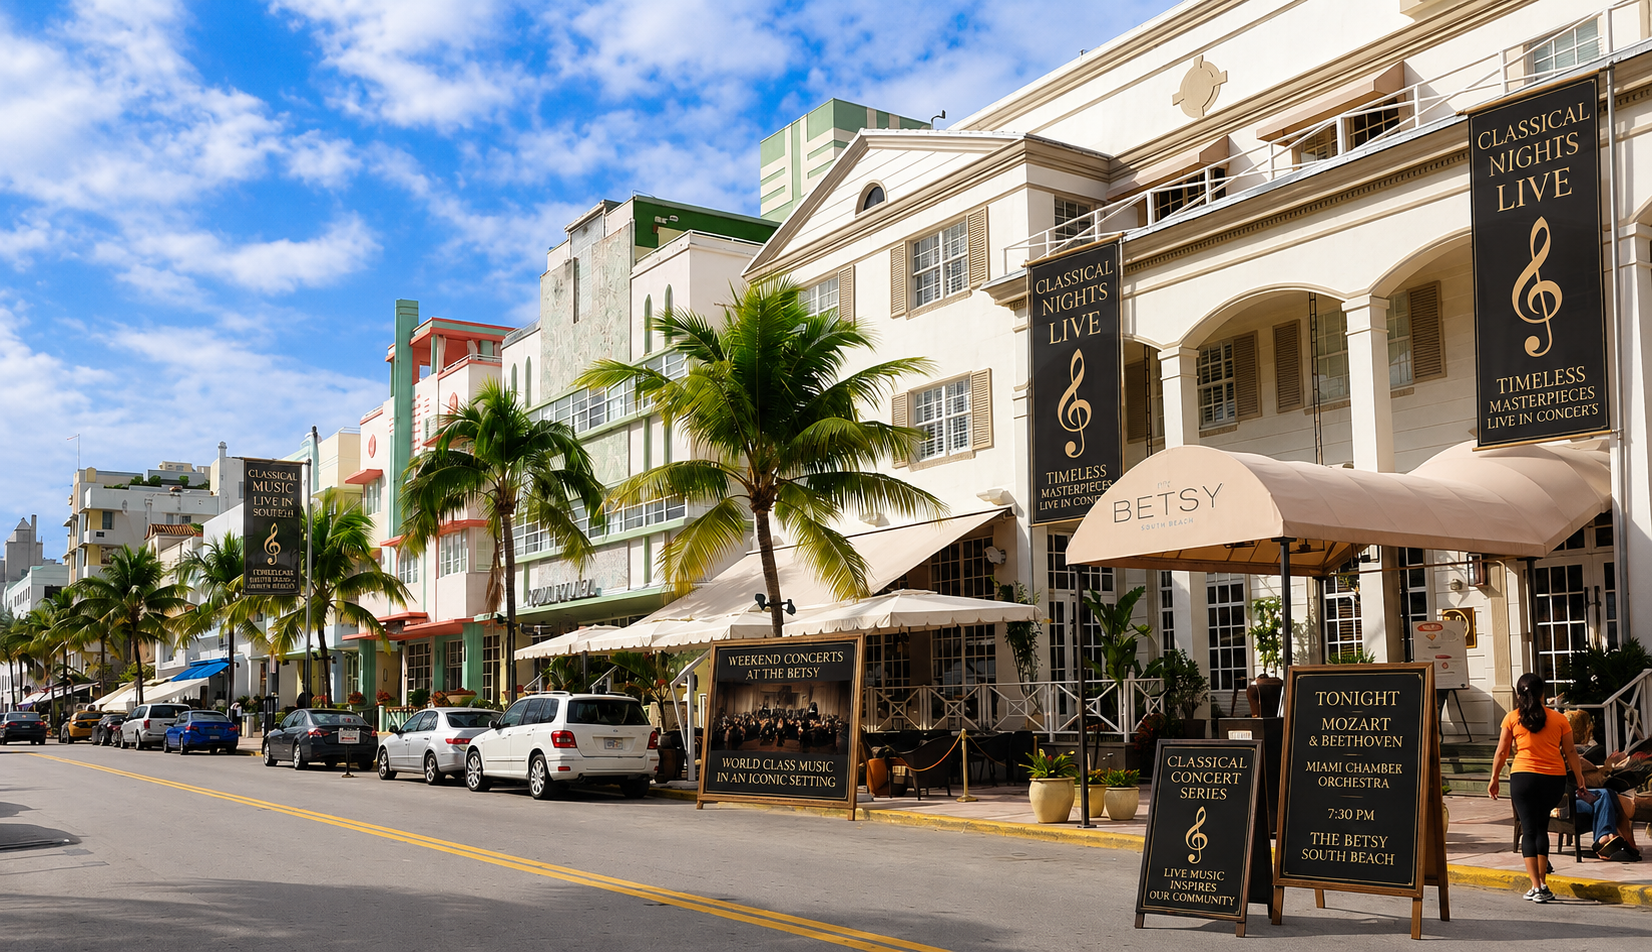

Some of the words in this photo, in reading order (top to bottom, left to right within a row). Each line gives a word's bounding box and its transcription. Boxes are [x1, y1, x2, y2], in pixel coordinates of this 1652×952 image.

[1478, 102, 1590, 150] CLASSICAL
[1489, 132, 1579, 177] NIGHTS
[1496, 167, 1572, 212] LIVE
[1036, 260, 1113, 294] CLASSICAL
[1042, 282, 1108, 316] NIGHTS
[1049, 311, 1101, 344] LIVE
[1496, 366, 1586, 394] TIMELESS
[1489, 386, 1595, 413] MASTERPIECES
[1487, 415, 1516, 429] LIVE
[1519, 412, 1533, 425] IN
[248, 469, 297, 481] CLASSICAL
[1046, 464, 1106, 484] TIMELESS
[252, 481, 294, 494] MUSIC
[254, 496, 278, 506] LIVE
[282, 497, 293, 507] IN
[1040, 500, 1058, 510] LIVE
[1061, 498, 1071, 508] IN
[1114, 483, 1222, 523] BETSY
[1141, 521, 1166, 531] SOUTH
[1169, 518, 1194, 527] BEACH
[728, 654, 781, 666] WEEKEND
[784, 651, 844, 664] CONCERTS
[746, 669, 760, 680] AT
[762, 668, 784, 679] THE
[787, 667, 820, 679] BETSY
[1315, 690, 1400, 706] TONIGHT
[1321, 717, 1391, 731] MOZART
[1309, 735, 1318, 746] &
[1321, 735, 1403, 748] BEETHOVEN
[722, 757, 760, 770] WORLD
[763, 759, 796, 771] CLASS
[799, 760, 834, 772] MUSIC
[1167, 755, 1247, 769] CLASSICAL
[1306, 761, 1342, 773] MIAMI
[1345, 762, 1402, 774] CHAMBER
[717, 772, 728, 782] IN
[730, 772, 746, 783] AN
[749, 773, 788, 786] ICONIC
[789, 775, 836, 788] SETTING
[1171, 771, 1242, 785] CONCERT
[1318, 776, 1390, 789] ORCHESTRA
[1180, 787, 1227, 800] SERIES
[1328, 808, 1353, 820] 7:30
[1356, 809, 1374, 821] PM
[1310, 832, 1340, 846] THE
[1344, 834, 1388, 849] BETSY
[1301, 848, 1346, 862] SOUTH
[1350, 851, 1395, 866] BEACH
[1164, 868, 1188, 878] LIVE
[1190, 869, 1225, 881] MUSIC
[1170, 880, 1217, 892] INSPIRES
[1150, 891, 1170, 901] OUR
[1172, 892, 1235, 906] COMMUNITY
